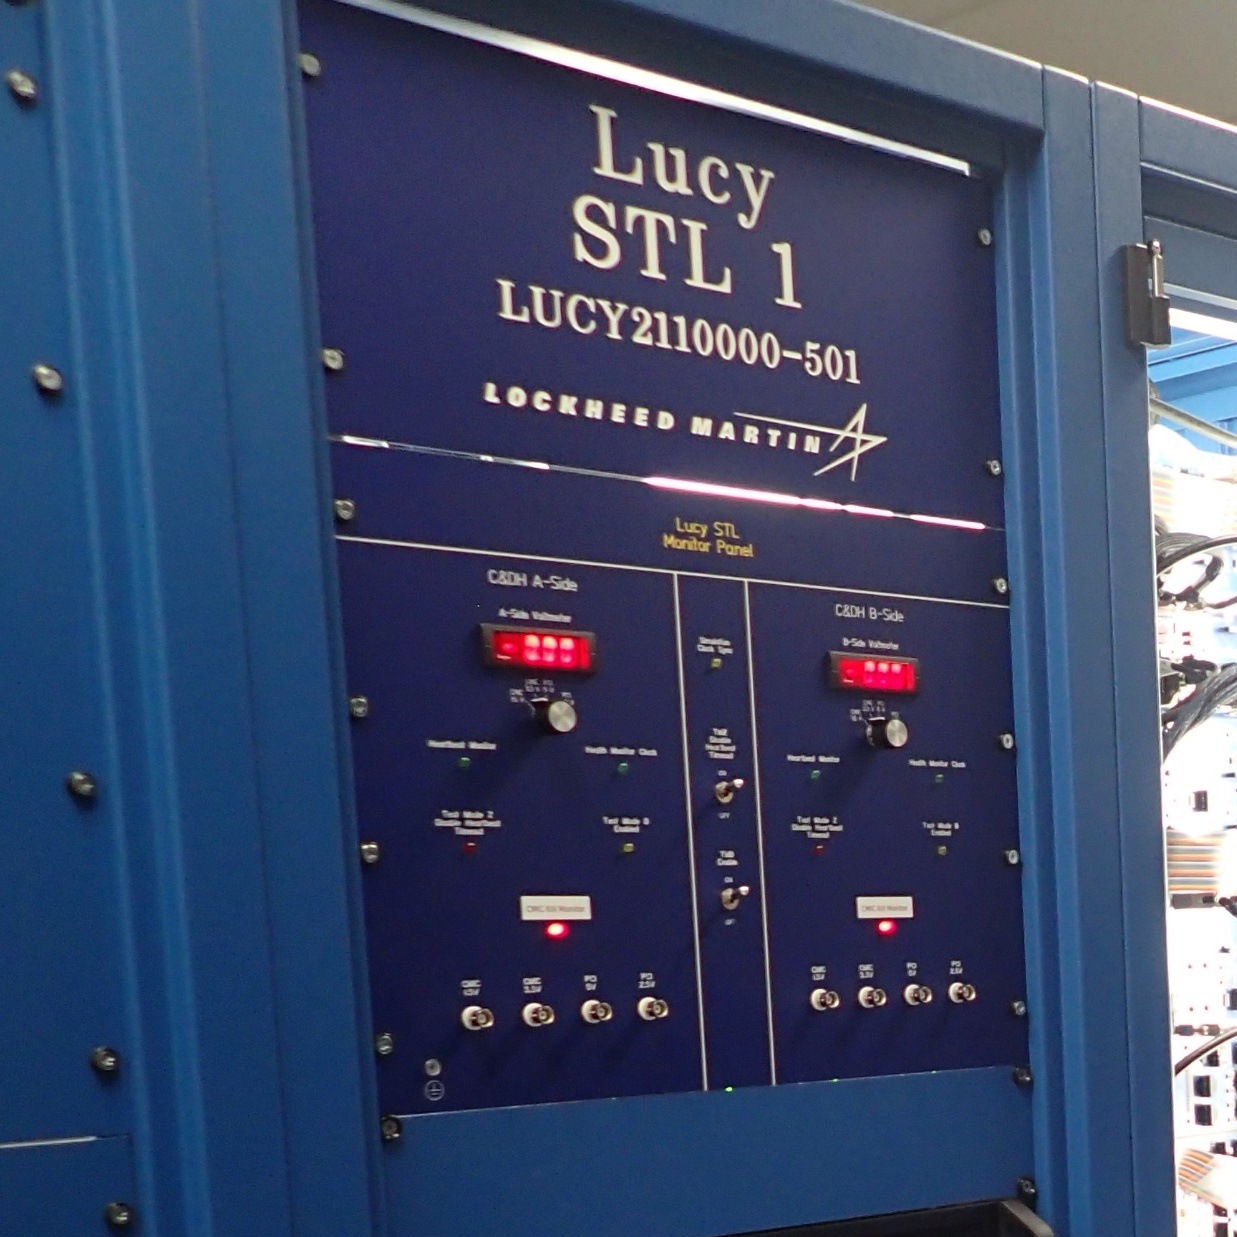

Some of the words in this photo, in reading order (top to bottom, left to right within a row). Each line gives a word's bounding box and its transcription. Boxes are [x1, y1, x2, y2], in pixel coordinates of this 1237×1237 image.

[590, 104, 775, 227] Lucy
[573, 195, 732, 295] STL
[772, 243, 802, 309] 1
[496, 279, 861, 384] LUCY2110000-501
[483, 382, 676, 431] LOCKHEED
[691, 415, 821, 454] MARTIN
[662, 532, 711, 552] Monitor
[716, 539, 754, 557] Panel
[675, 517, 708, 538] Lucy
[713, 521, 740, 539] STL
[532, 574, 579, 592] A-Side
[835, 603, 866, 618] C&DH
[868, 606, 905, 622] B-Side
